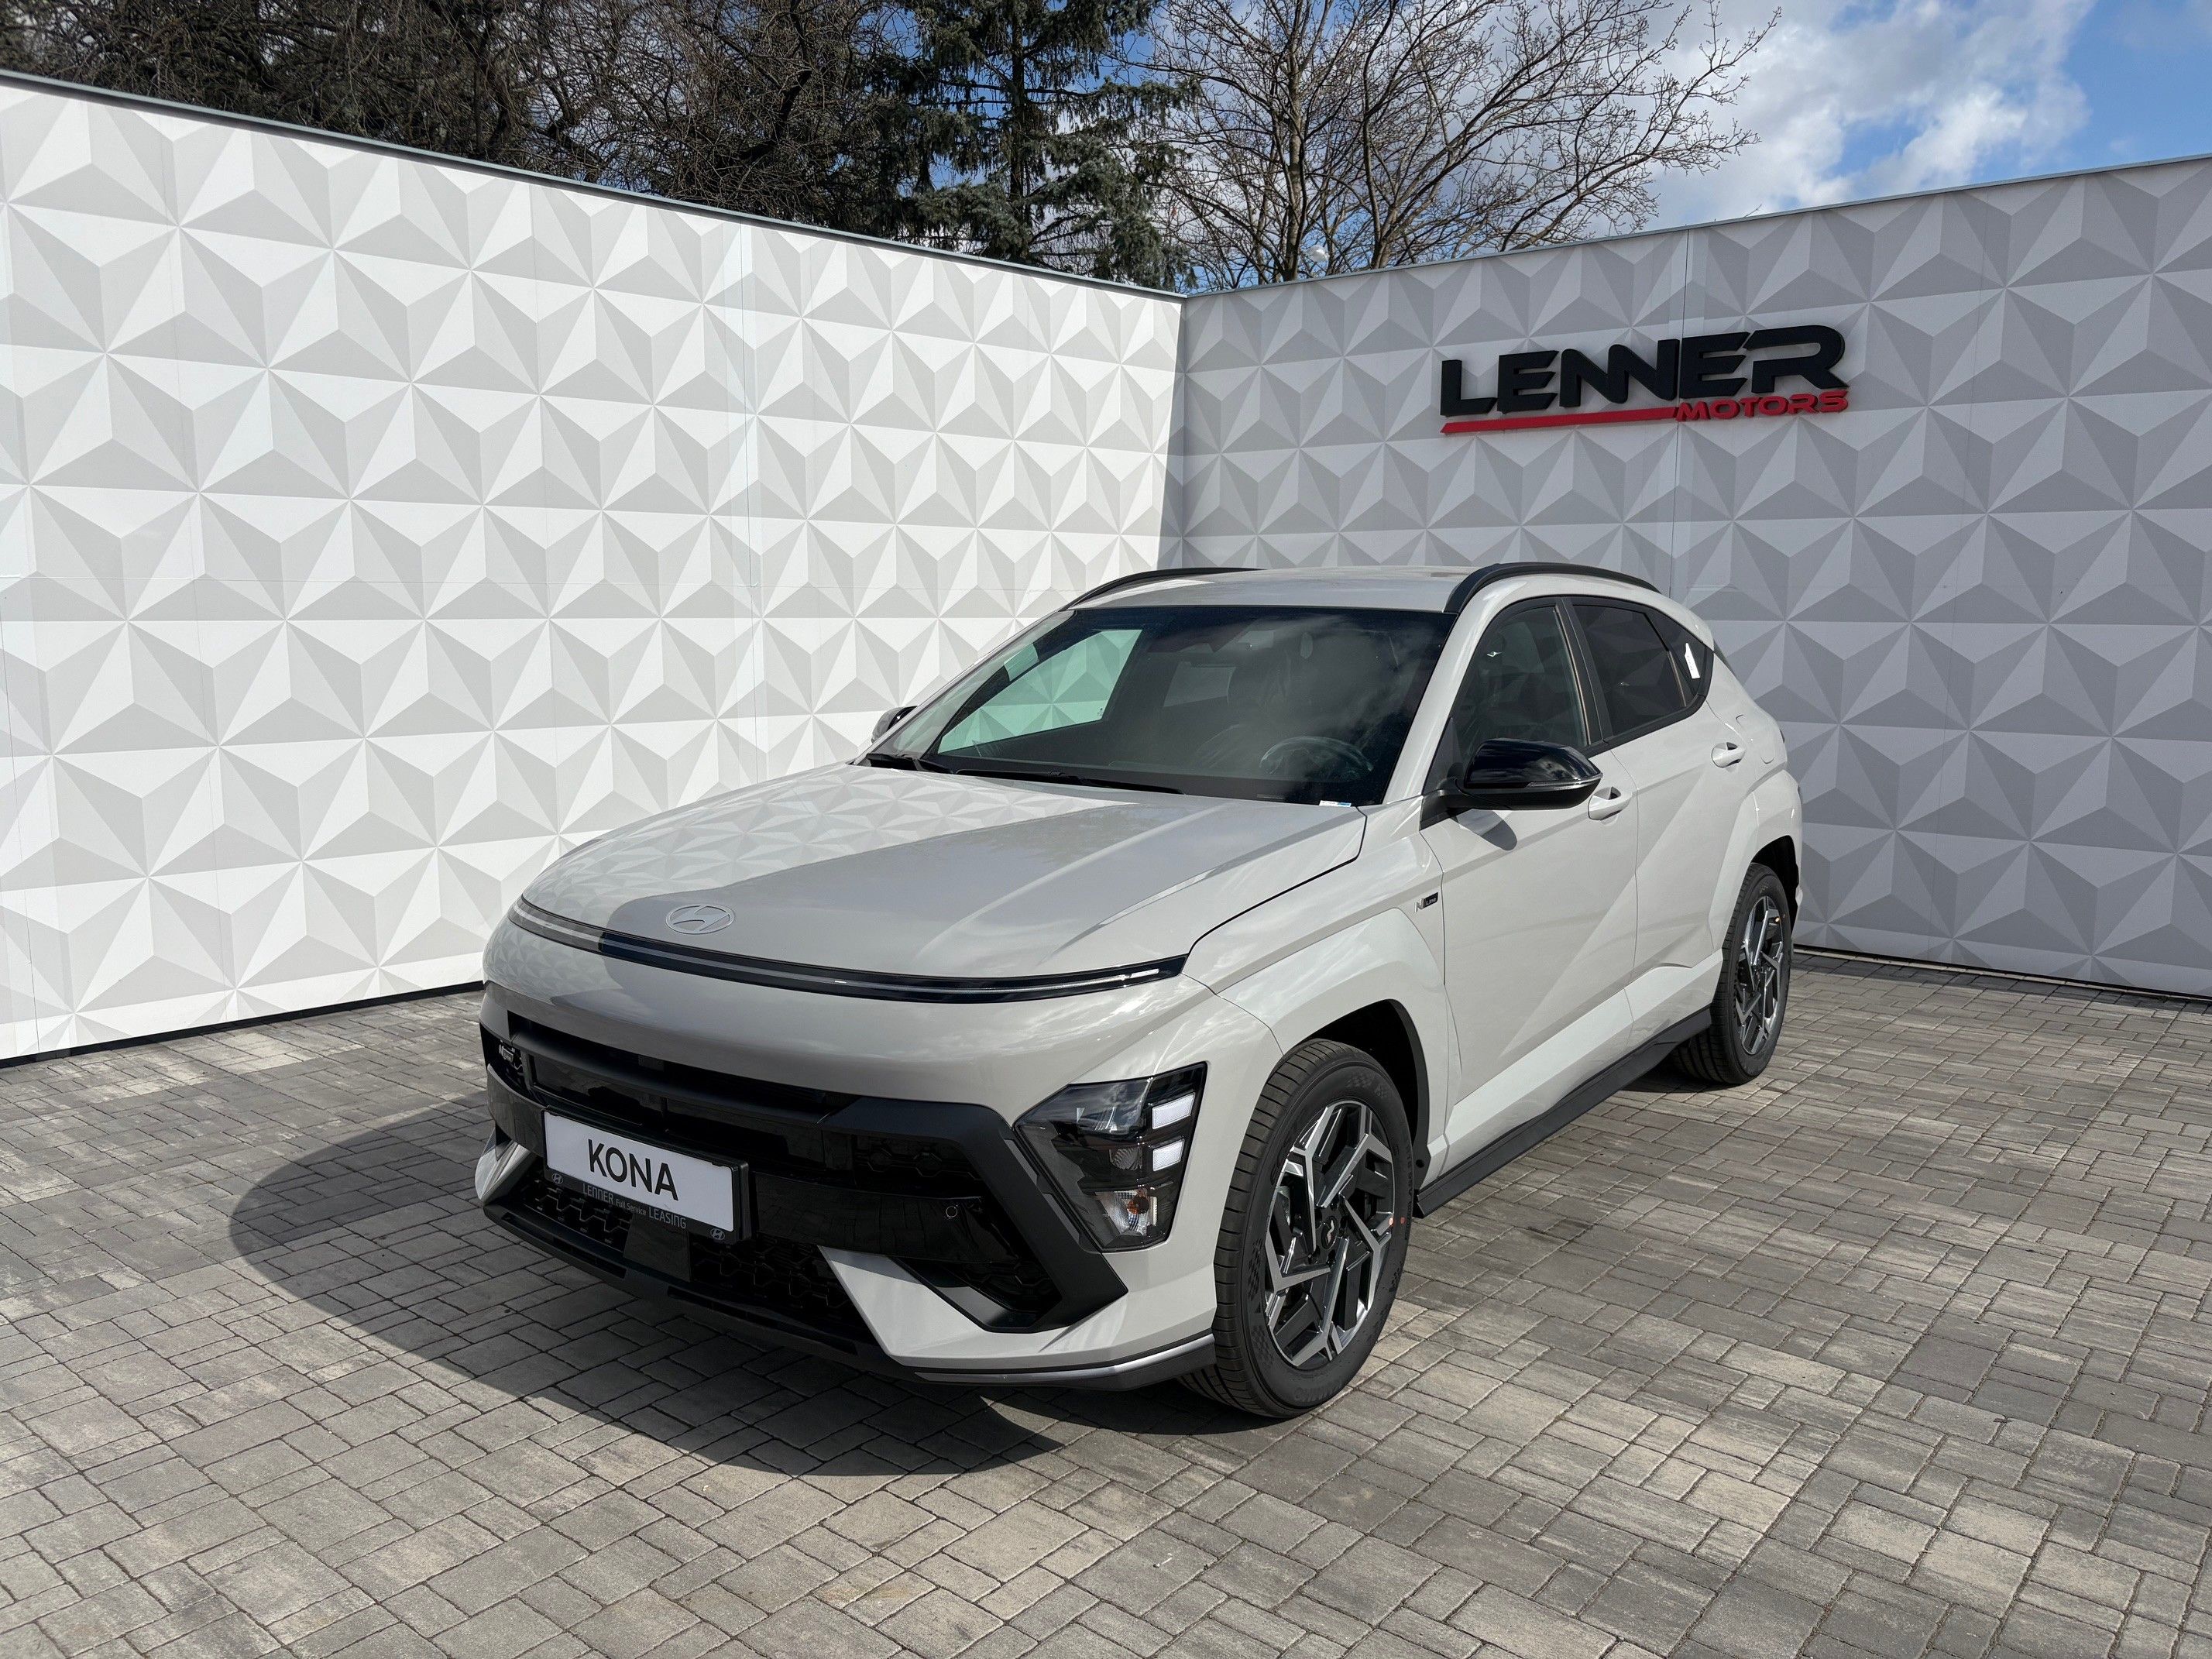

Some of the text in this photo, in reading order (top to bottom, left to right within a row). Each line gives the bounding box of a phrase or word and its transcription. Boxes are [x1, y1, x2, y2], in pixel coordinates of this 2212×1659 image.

[1440, 324, 1850, 417] LENNER
[1676, 389, 1850, 422] MOTORS
[587, 1138, 678, 1201] KONA
[582, 1183, 687, 1229] LENNER Full Service LEASING
